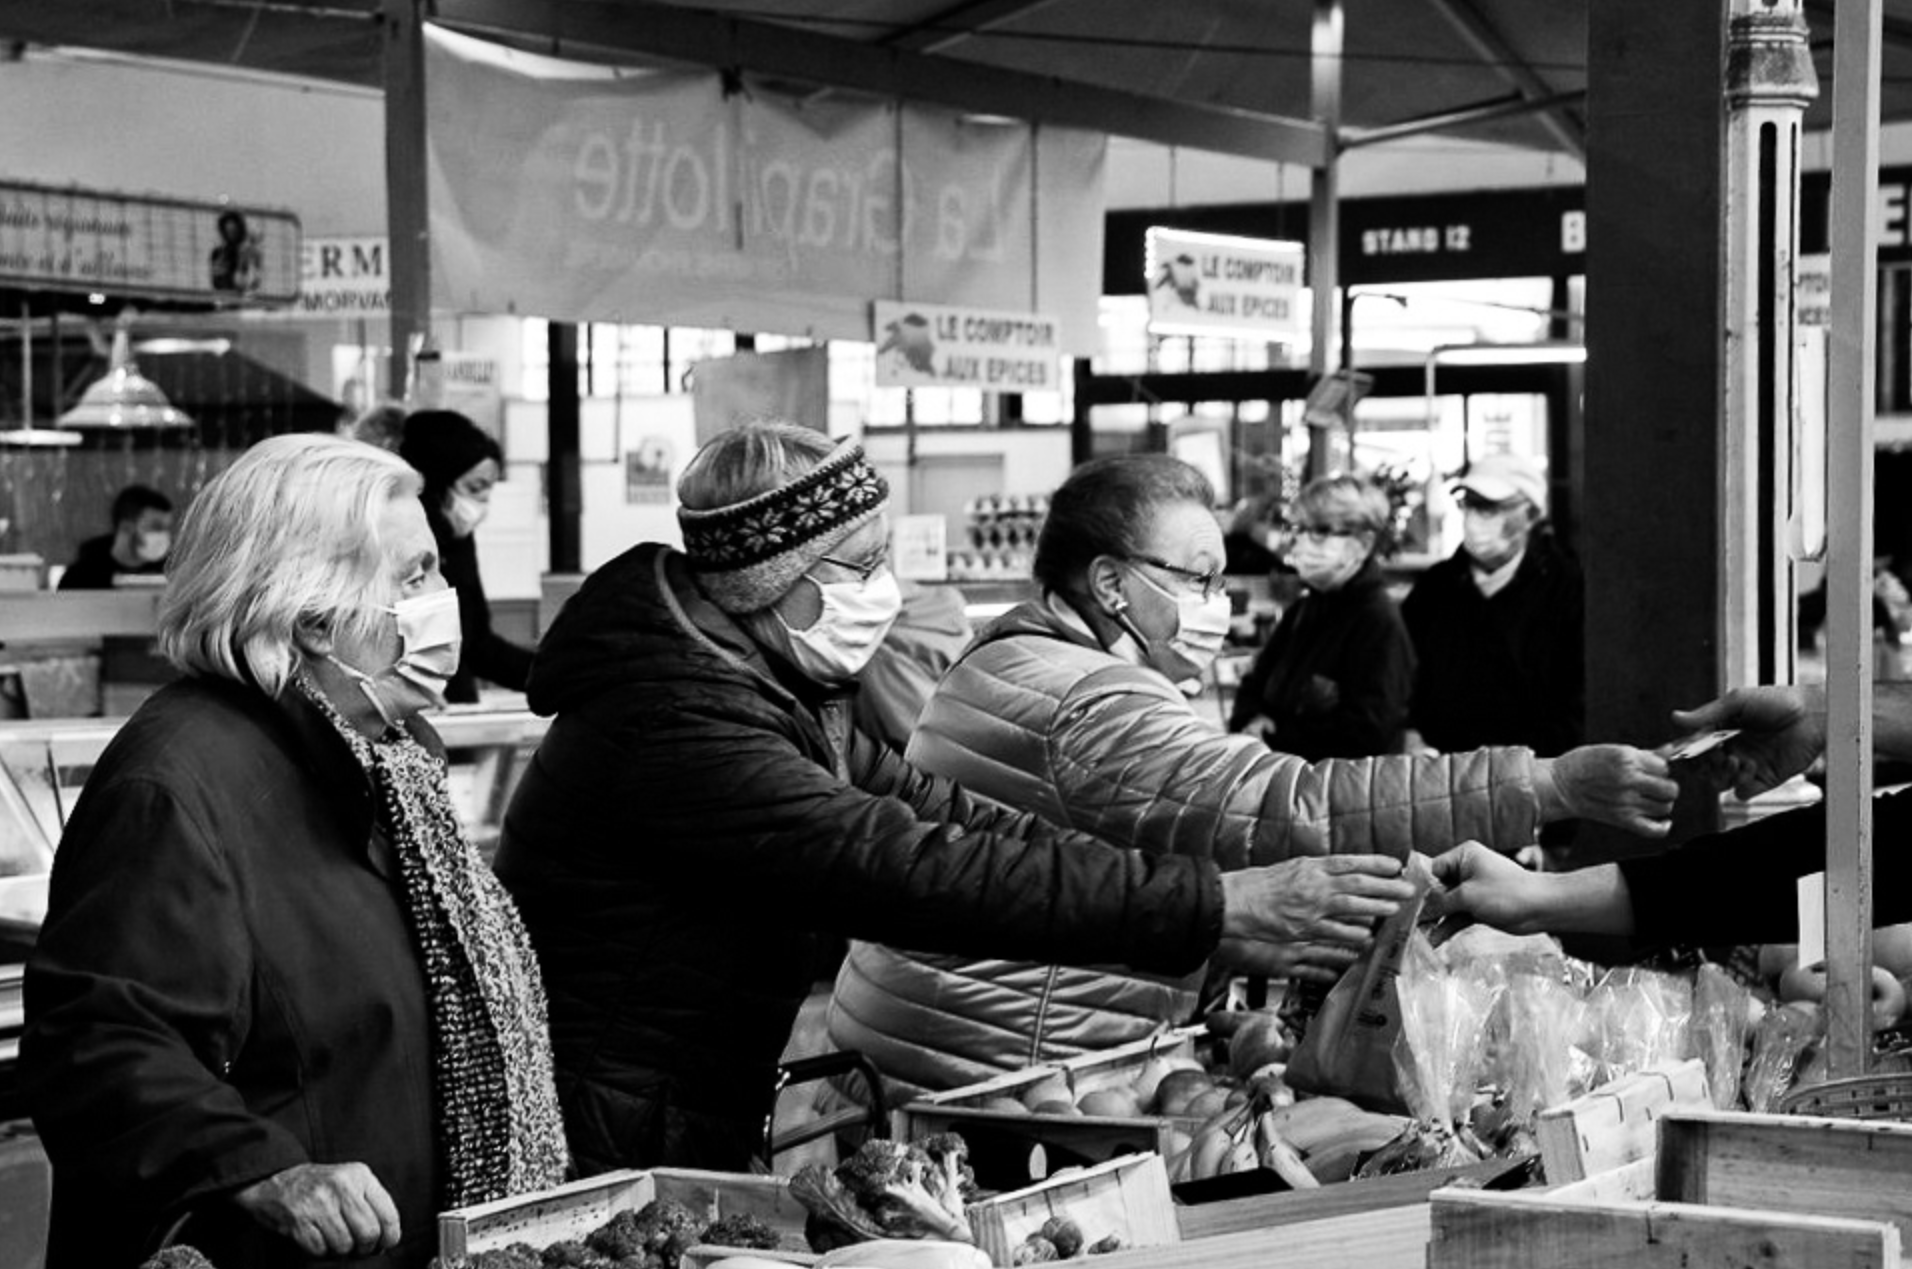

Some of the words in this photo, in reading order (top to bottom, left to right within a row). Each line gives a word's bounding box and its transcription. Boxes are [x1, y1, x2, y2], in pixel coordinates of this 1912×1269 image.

[1363, 227, 1438, 254] STAND
[1446, 224, 1470, 251] 12
[1202, 255, 1219, 279] LE
[1225, 257, 1294, 284] COMPTOIR
[303, 289, 390, 311] MORVA
[1207, 292, 1235, 315] AUX
[936, 315, 957, 342] LE
[964, 316, 1053, 347] COMPTOIR
[942, 356, 979, 381] AUX
